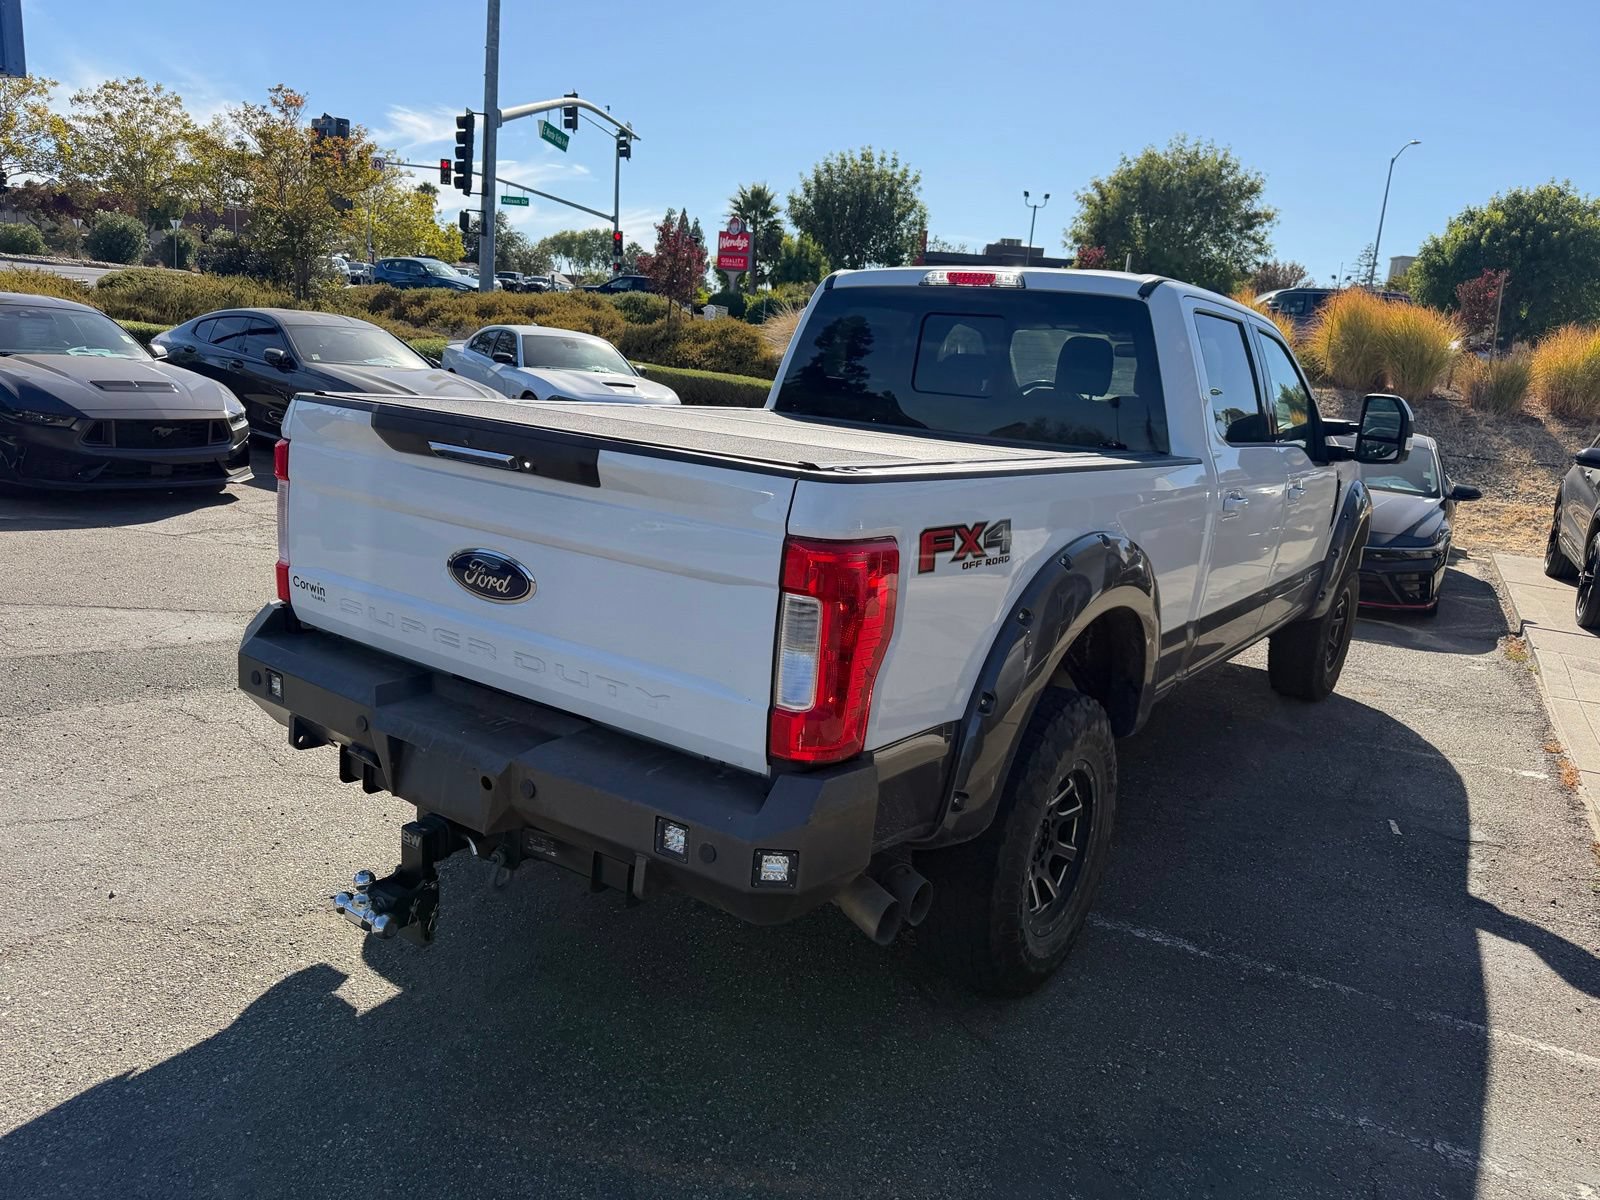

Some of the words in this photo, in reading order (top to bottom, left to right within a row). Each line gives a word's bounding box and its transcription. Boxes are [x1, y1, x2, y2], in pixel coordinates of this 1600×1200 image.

[502, 197, 520, 205] Allison
[720, 235, 749, 250] Wendy's
[918, 518, 1011, 575] FX4
[962, 560, 982, 570] OFF
[985, 555, 1011, 567] ROAD
[293, 575, 326, 597] Corwin
[464, 558, 512, 593] Ford
[339, 597, 497, 660] SUPER
[512, 650, 671, 709] DUTY
